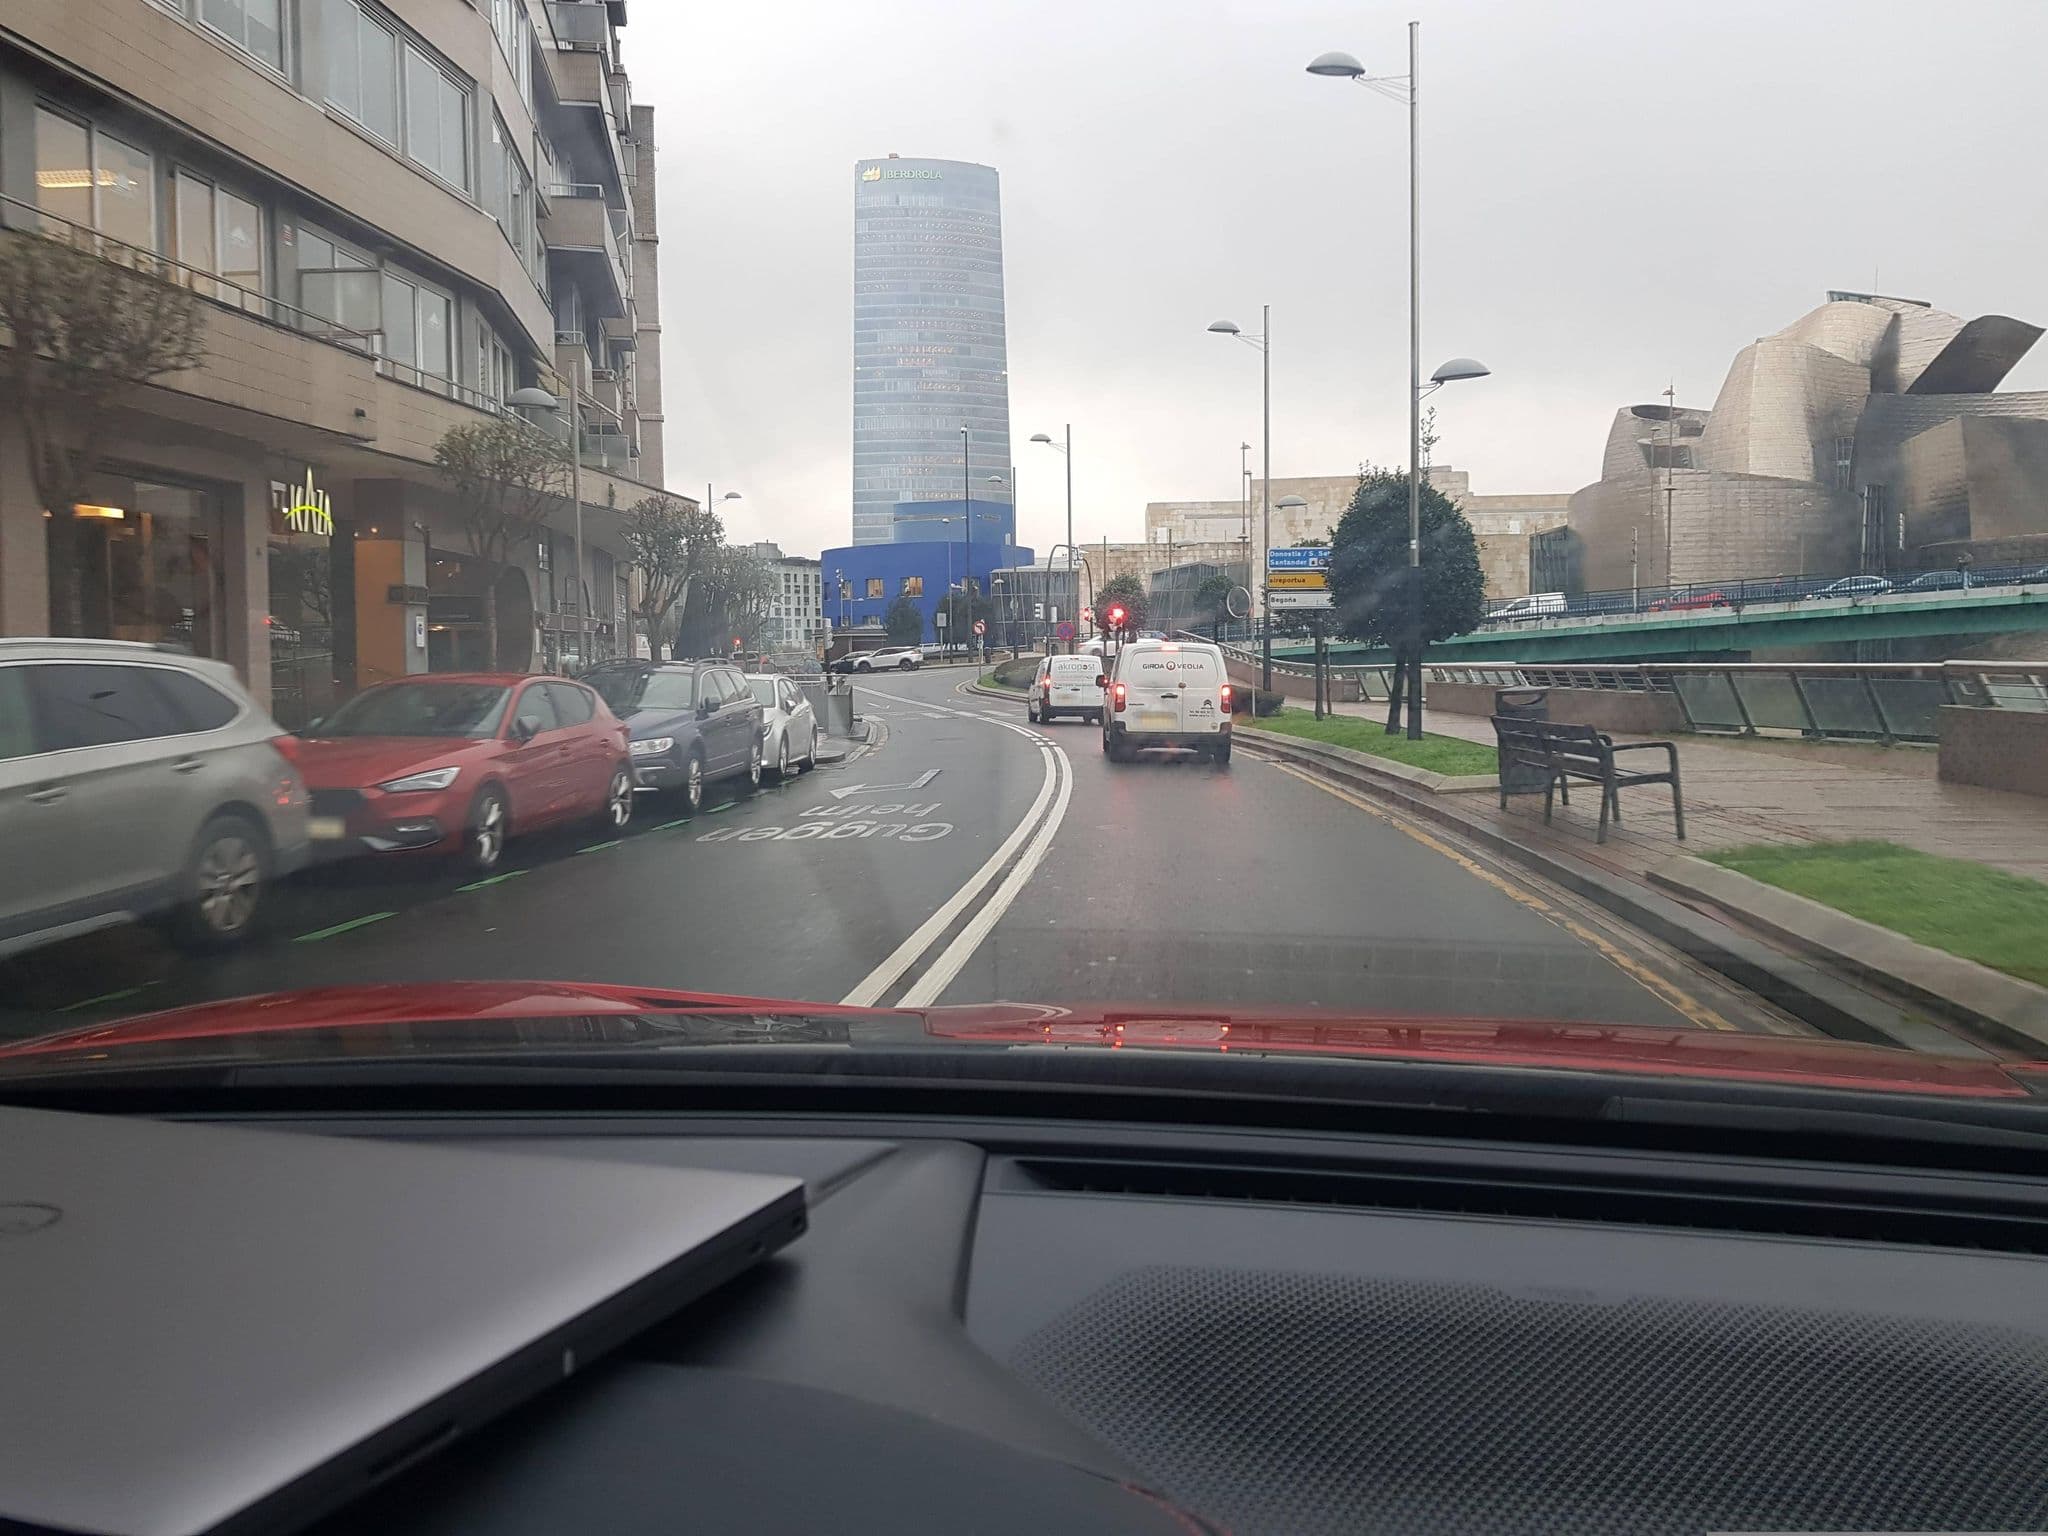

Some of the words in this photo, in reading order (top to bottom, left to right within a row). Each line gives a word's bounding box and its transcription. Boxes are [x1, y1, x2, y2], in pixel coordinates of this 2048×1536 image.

[883, 169, 943, 180] IBERDROLA
[1057, 663, 1095, 671] akropost
[799, 803, 942, 819] heim
[695, 821, 954, 842] Guggen
